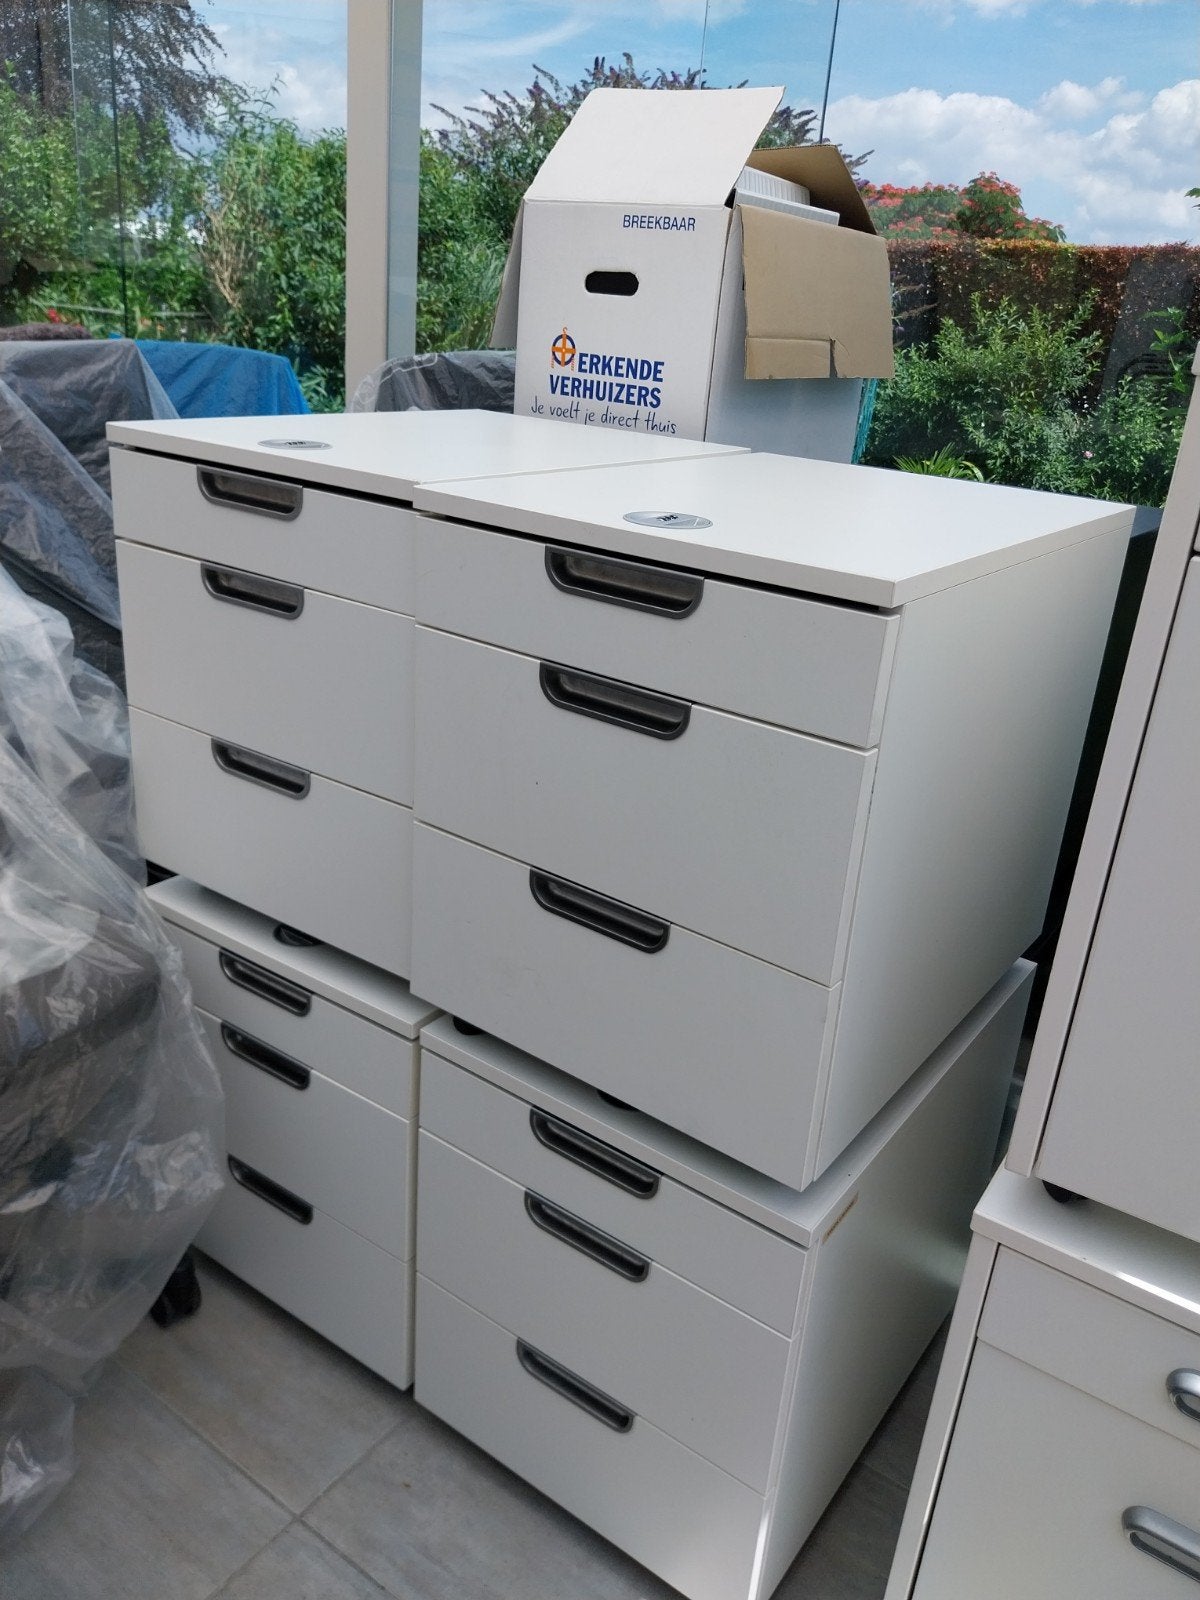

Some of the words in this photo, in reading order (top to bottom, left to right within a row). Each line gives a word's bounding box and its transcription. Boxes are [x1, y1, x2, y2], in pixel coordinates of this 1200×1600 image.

[622, 214, 696, 231] BREEKBAAR
[577, 352, 665, 382] ERKENDE
[549, 374, 661, 409] VERHUIZERS
[530, 395, 545, 415] Je
[549, 400, 580, 420] voelt
[584, 409, 596, 426] je
[600, 406, 640, 429] direct
[644, 411, 678, 435] thuis
